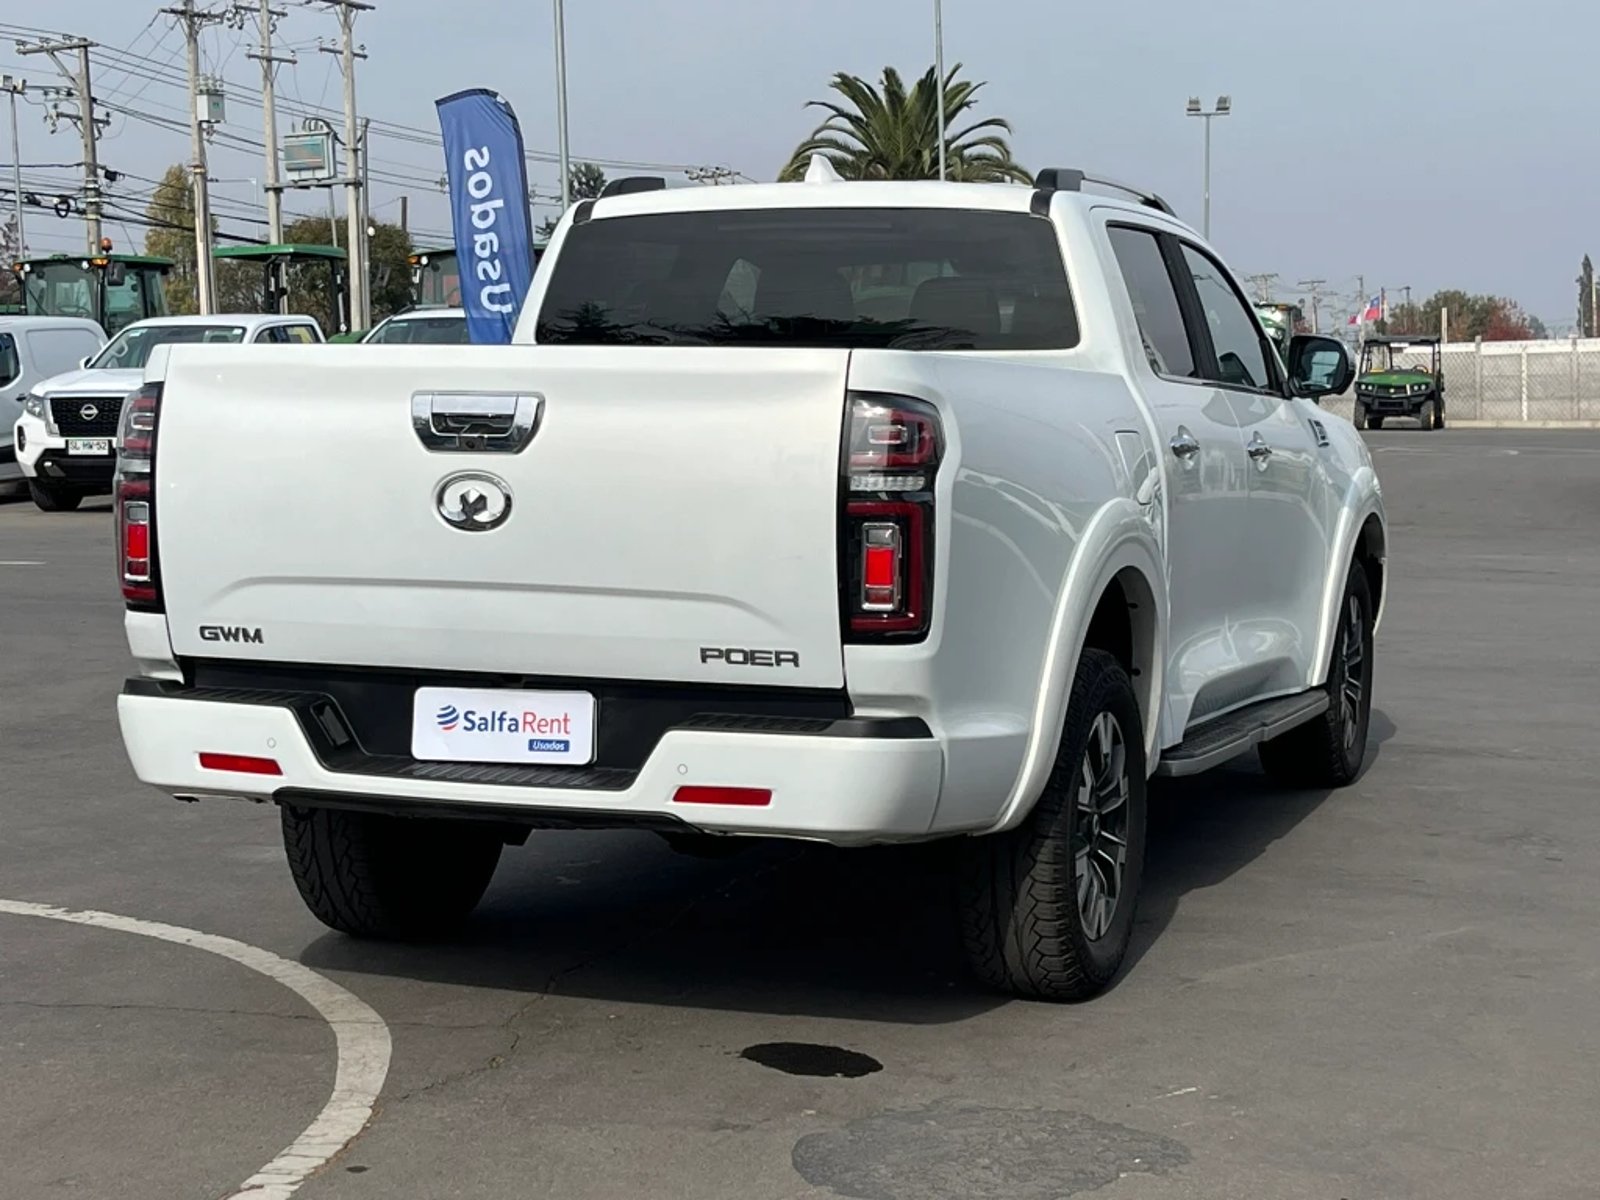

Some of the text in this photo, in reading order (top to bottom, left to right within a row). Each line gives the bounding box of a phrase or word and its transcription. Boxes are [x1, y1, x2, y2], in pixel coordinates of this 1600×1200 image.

[199, 626, 264, 644] GWM
[700, 648, 799, 667] POER
[463, 711, 571, 734] SalfaRent
[533, 741, 566, 751] Usados
